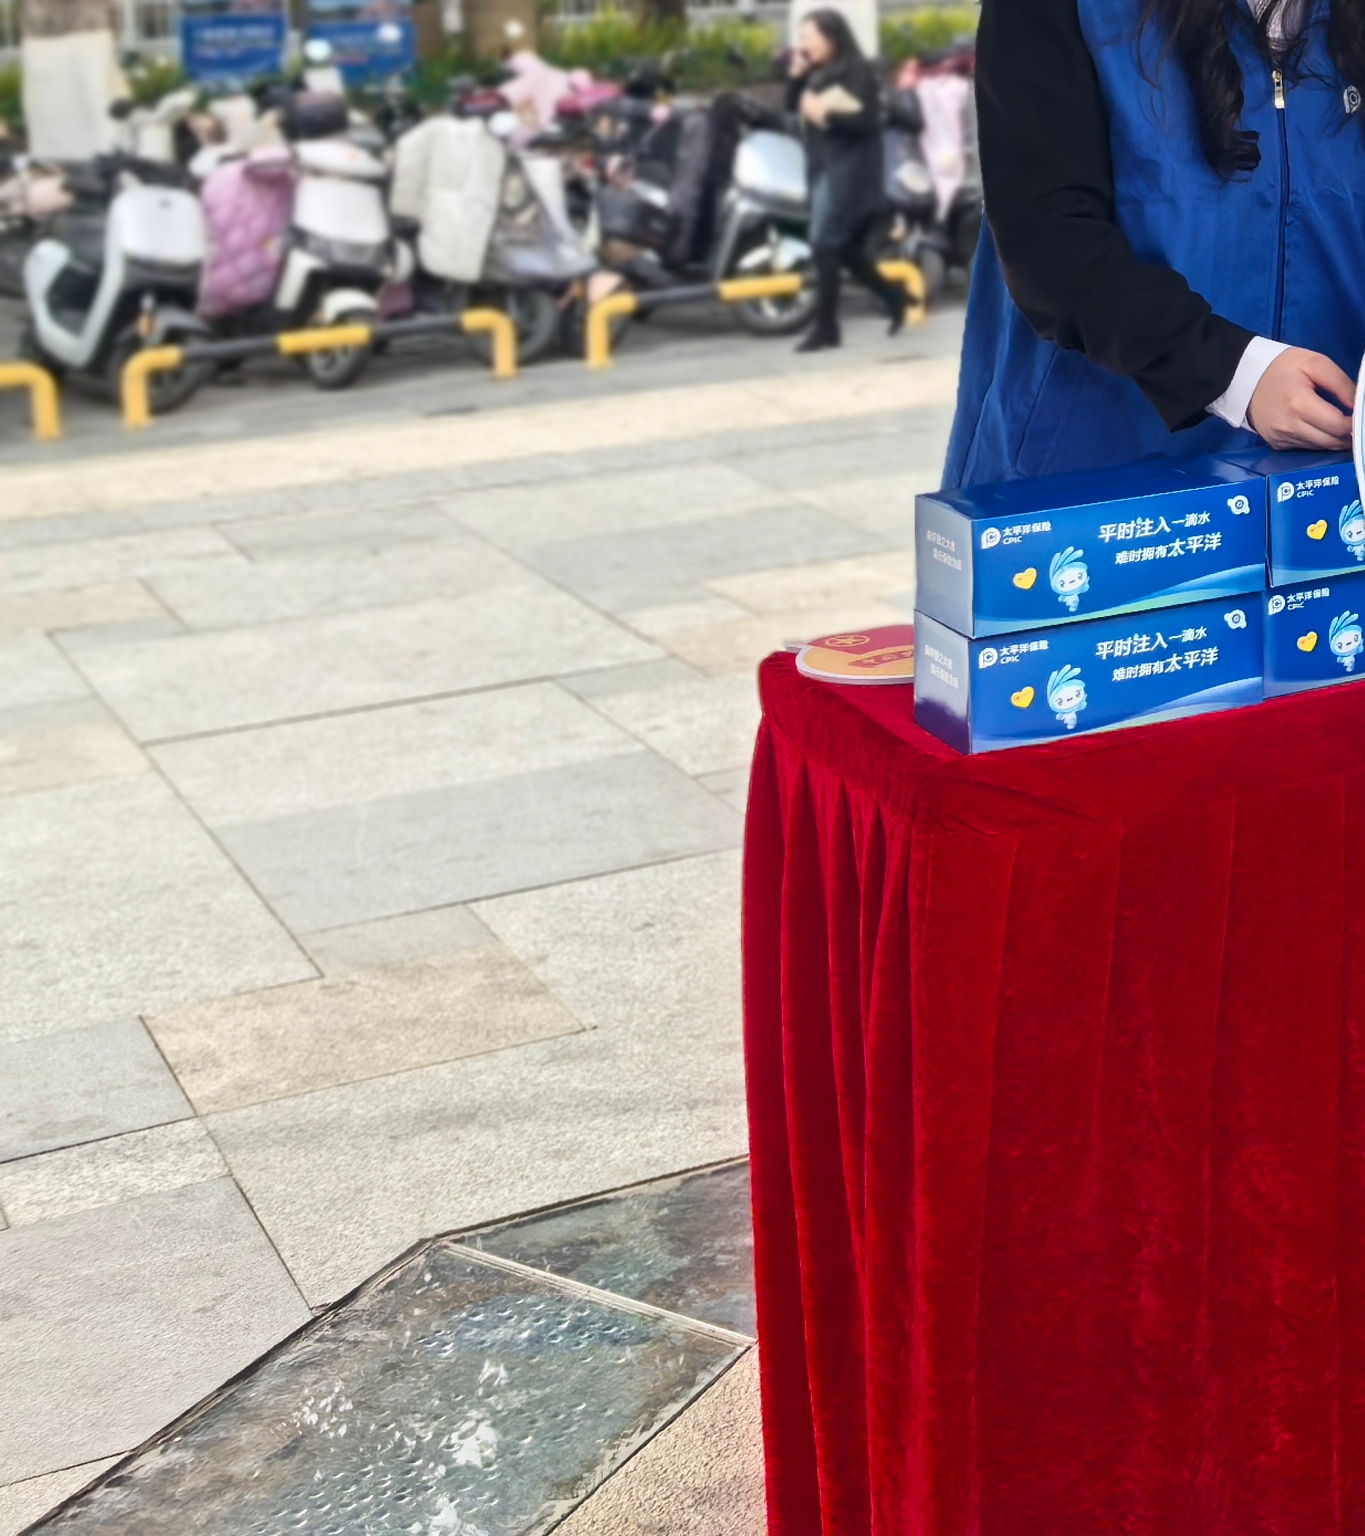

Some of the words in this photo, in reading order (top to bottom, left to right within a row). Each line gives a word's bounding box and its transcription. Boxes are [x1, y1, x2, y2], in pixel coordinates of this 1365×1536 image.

[1296, 476, 1340, 491] 太平洋保险
[1002, 521, 1052, 537] 太平洋保险
[1098, 511, 1210, 544] 平时注入一滴水
[1115, 532, 1222, 565] 难时拥有太平洋
[1286, 587, 1330, 604] 太平洋保险
[1000, 639, 1049, 657] 太平洋保险
[1095, 626, 1207, 661] 平时注入一滴水
[1112, 646, 1219, 682] 难时拥有太平洋
